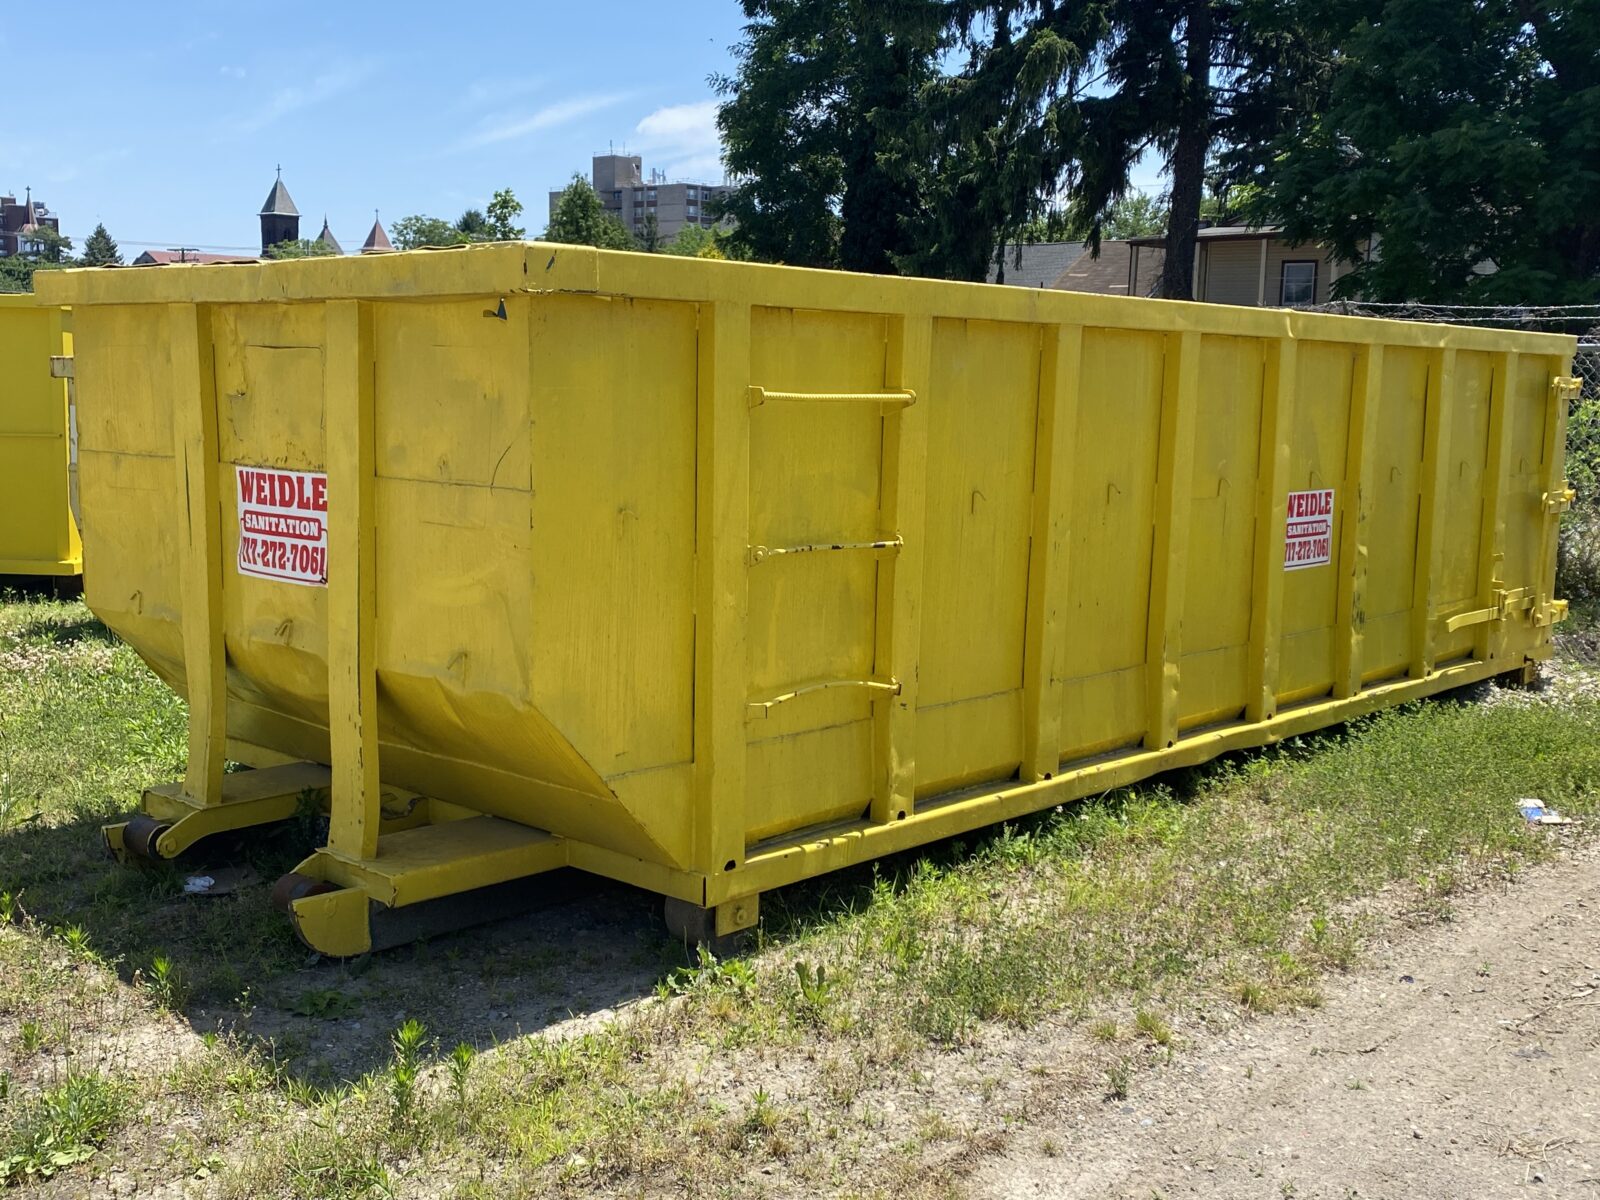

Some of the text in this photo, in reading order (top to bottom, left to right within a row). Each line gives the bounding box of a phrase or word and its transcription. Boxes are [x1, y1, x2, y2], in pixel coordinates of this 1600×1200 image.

[239, 470, 327, 512] WEIDLE
[245, 513, 319, 537] SANITATION
[1288, 522, 1327, 536] SANITATION
[242, 537, 326, 576] 717-272-7061
